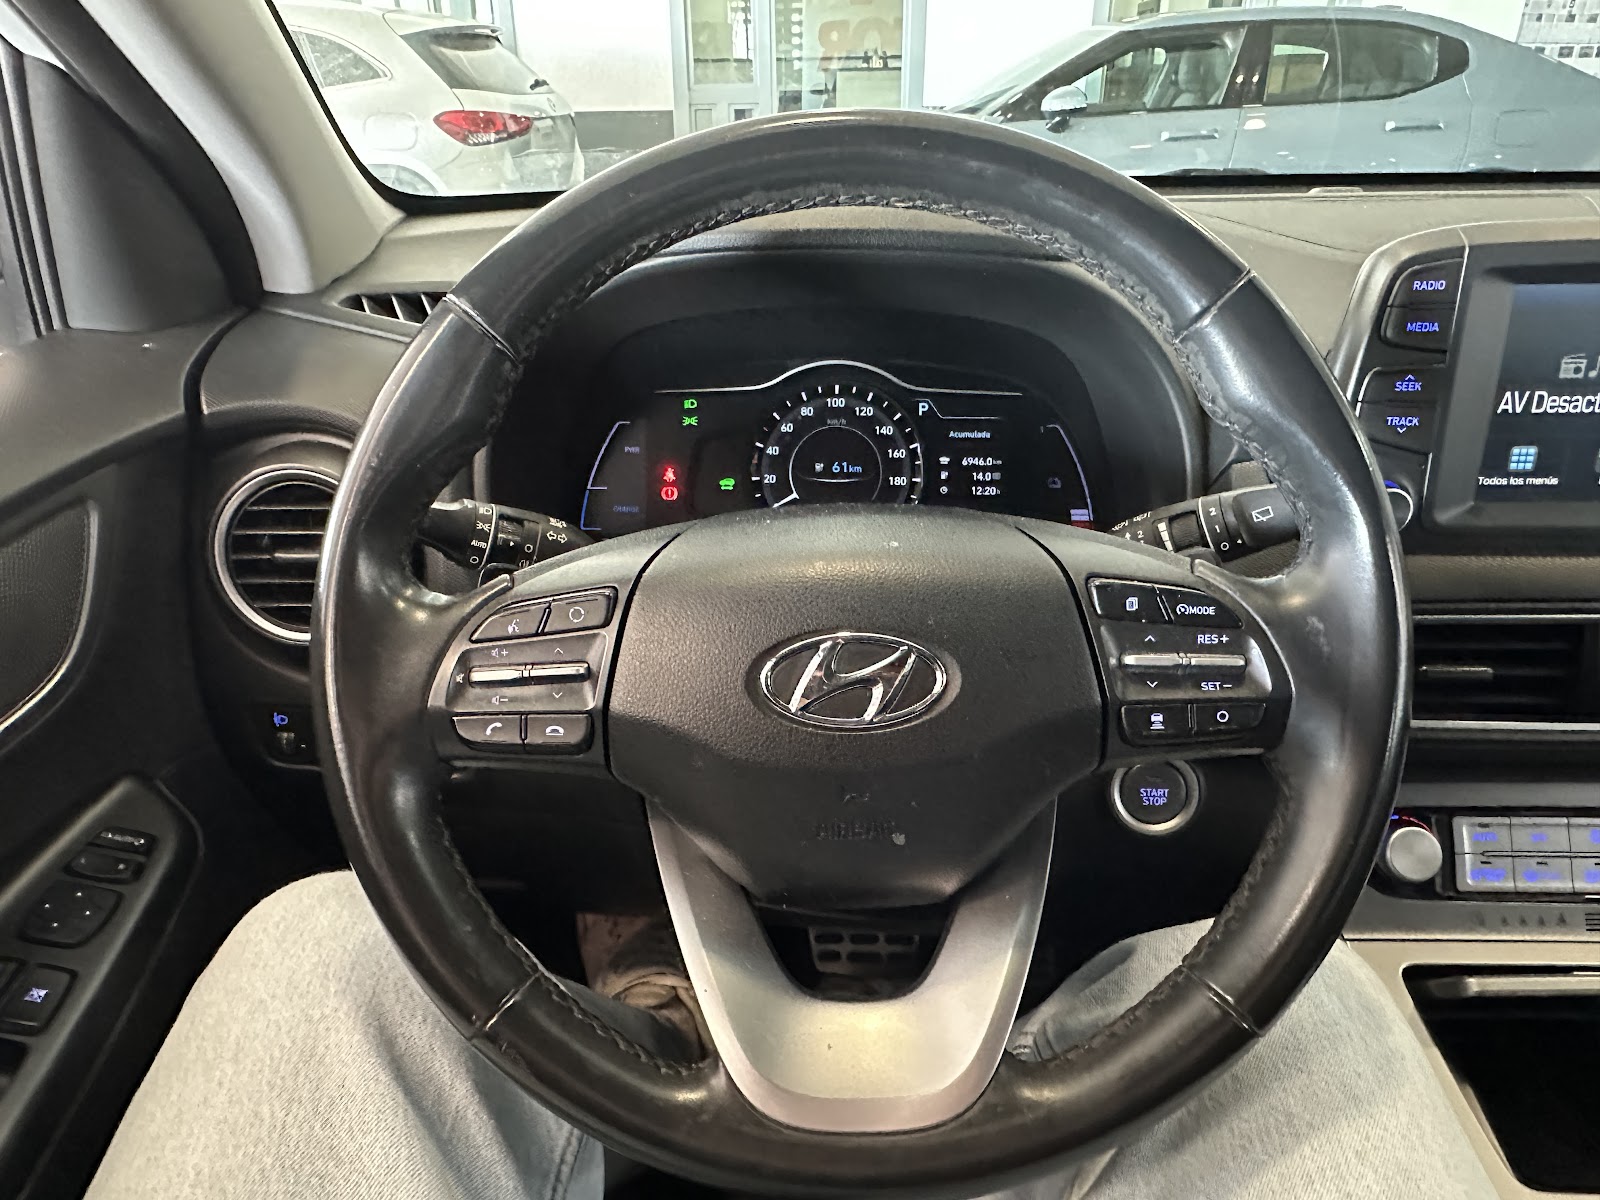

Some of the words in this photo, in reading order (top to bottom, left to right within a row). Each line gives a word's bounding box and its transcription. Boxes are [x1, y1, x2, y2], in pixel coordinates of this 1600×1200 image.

[1412, 280, 1446, 291] RADIO
[1406, 322, 1439, 332] MEDIA
[1394, 381, 1422, 392] SEEK
[826, 397, 846, 408] 100
[1497, 390, 1531, 414] AV
[800, 406, 815, 417] 80
[855, 406, 874, 417] 120
[918, 402, 929, 416] P
[1386, 416, 1420, 427] TRACK
[780, 422, 794, 433] 60
[875, 425, 894, 435] 140
[948, 430, 991, 439] Acumulada
[766, 446, 780, 456] 40
[888, 449, 906, 460] 160
[763, 474, 777, 484] 20
[972, 471, 992, 481] 14.0
[1477, 476, 1508, 485] Todos
[1509, 476, 1524, 485] los
[1525, 475, 1559, 485] menús
[889, 476, 907, 487] 180
[470, 539, 488, 549] AUTO
[1189, 605, 1216, 615] MODE
[1140, 788, 1170, 797] START
[1142, 796, 1168, 806] STOP
